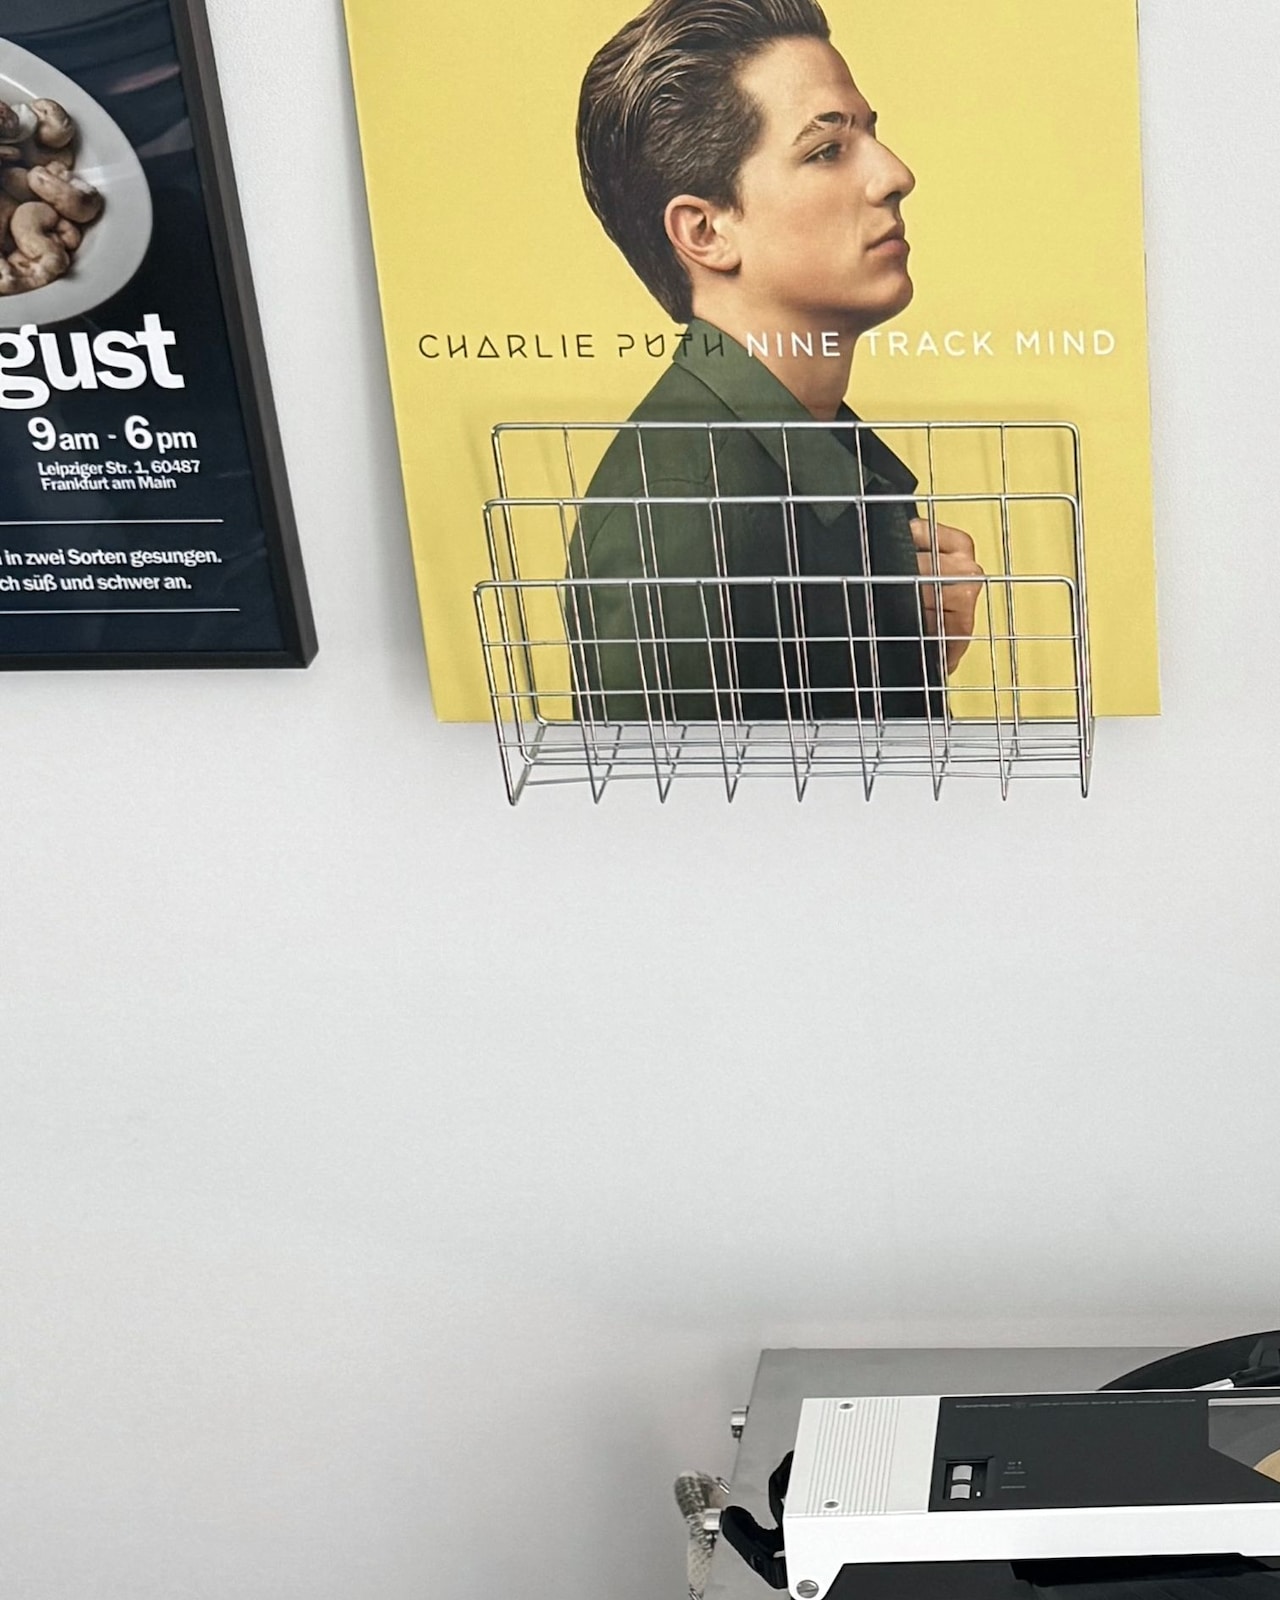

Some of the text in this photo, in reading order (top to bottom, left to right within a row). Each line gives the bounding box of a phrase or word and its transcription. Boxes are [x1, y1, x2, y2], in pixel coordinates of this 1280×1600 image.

[418, 329, 1116, 359] CHARLIE PUTH NINE TRACK MIND
[0, 313, 186, 410] gust
[37, 461, 104, 478] Leipziger
[105, 460, 132, 475] Str.
[151, 459, 201, 474] 60487
[41, 474, 178, 491] Frankfurt am Main
[4, 549, 23, 566] in
[24, 548, 66, 566] zwei
[67, 548, 127, 566] Sorten
[129, 549, 223, 568] gesungen.
[22, 573, 58, 593] süß
[60, 574, 95, 591] und
[96, 574, 160, 590] schwer
[163, 576, 192, 590] an.
